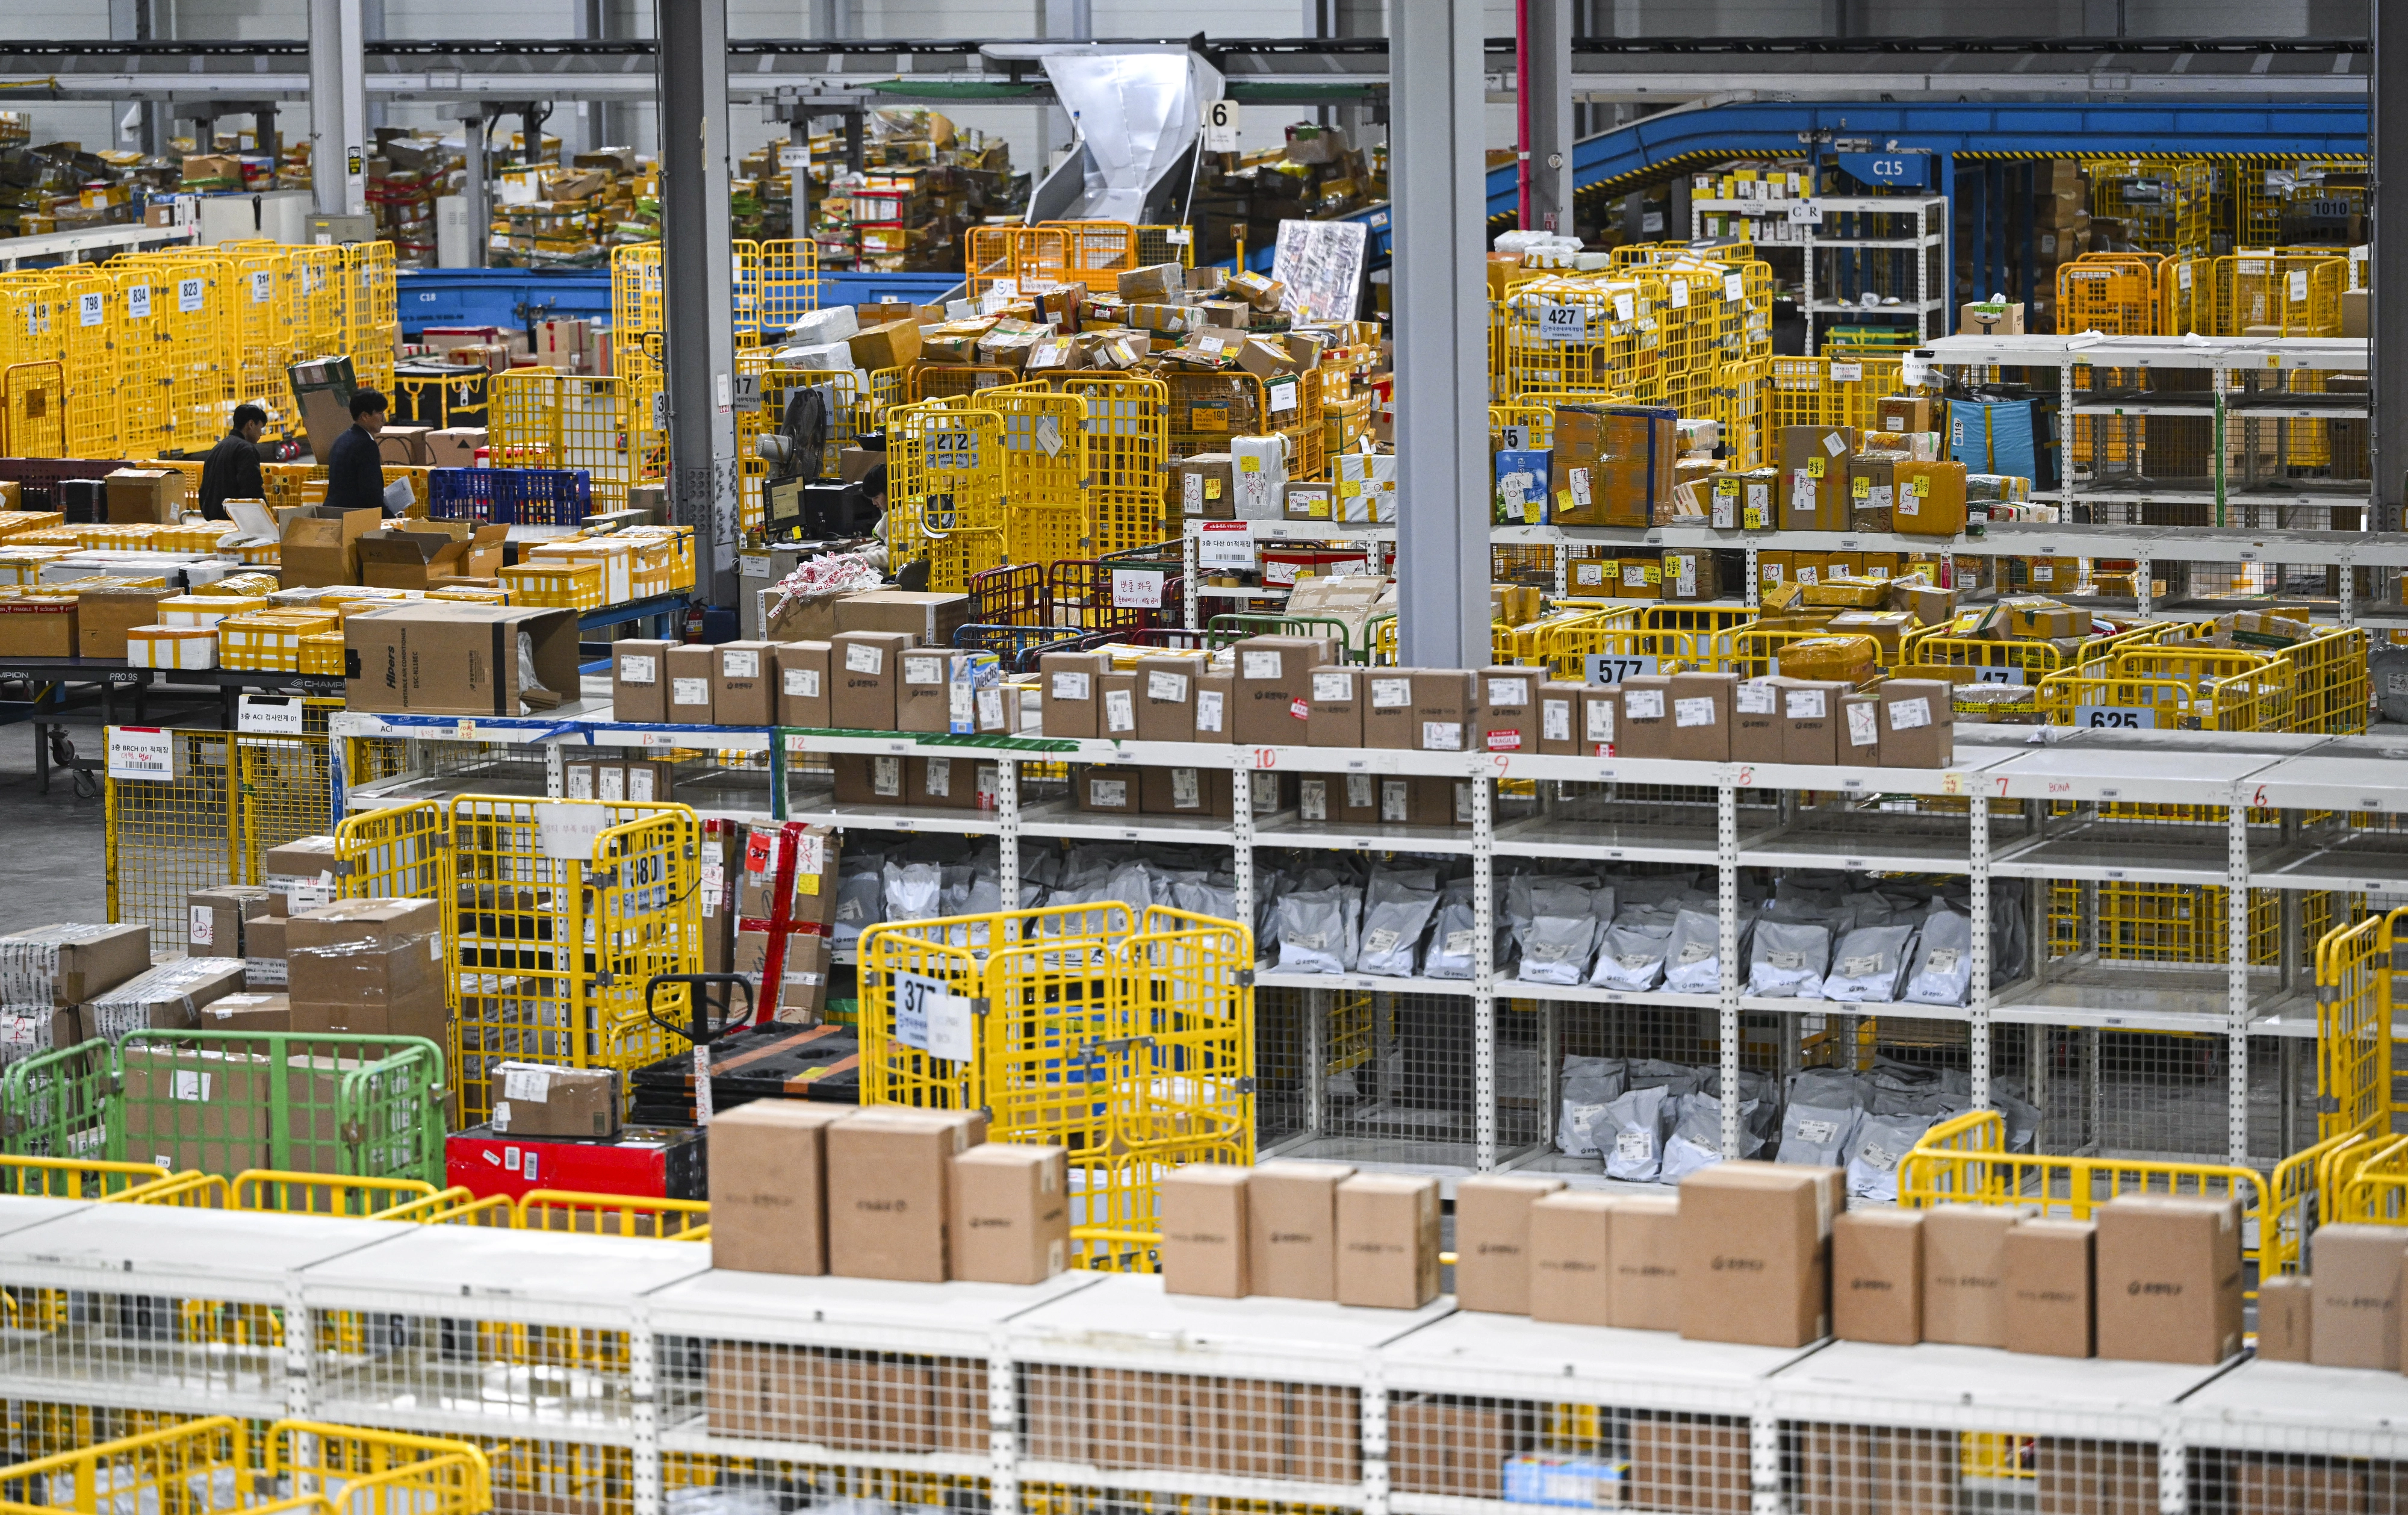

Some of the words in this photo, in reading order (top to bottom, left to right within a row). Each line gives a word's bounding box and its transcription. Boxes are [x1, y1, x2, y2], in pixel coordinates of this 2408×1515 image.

[1212, 104, 1227, 126] 6
[1873, 161, 1903, 175] C15
[1793, 207, 1801, 217] C
[1809, 207, 1819, 217] R
[2312, 202, 2347, 215] 1010
[132, 288, 146, 302] 834
[183, 282, 197, 297] 823
[85, 296, 99, 311] 798
[1548, 309, 1575, 324] 427
[736, 378, 752, 394] 17
[1213, 411, 1225, 421] 190
[1120, 580, 1134, 592] 반출
[1137, 580, 1153, 592] 화물
[128, 673, 138, 681] 9S
[974, 665, 998, 688] Welch's
[1599, 660, 1642, 683] 577
[2090, 712, 2138, 729] 625
[792, 736, 805, 748] 12
[1490, 736, 1516, 744] FRAGILE
[150, 745, 169, 753] 적재장
[1254, 748, 1276, 768] 10
[1494, 755, 1509, 778] 9
[1739, 767, 1752, 786] 8
[1996, 777, 2009, 797] 7
[2049, 782, 2070, 792] BONA
[2253, 785, 2268, 807] 6
